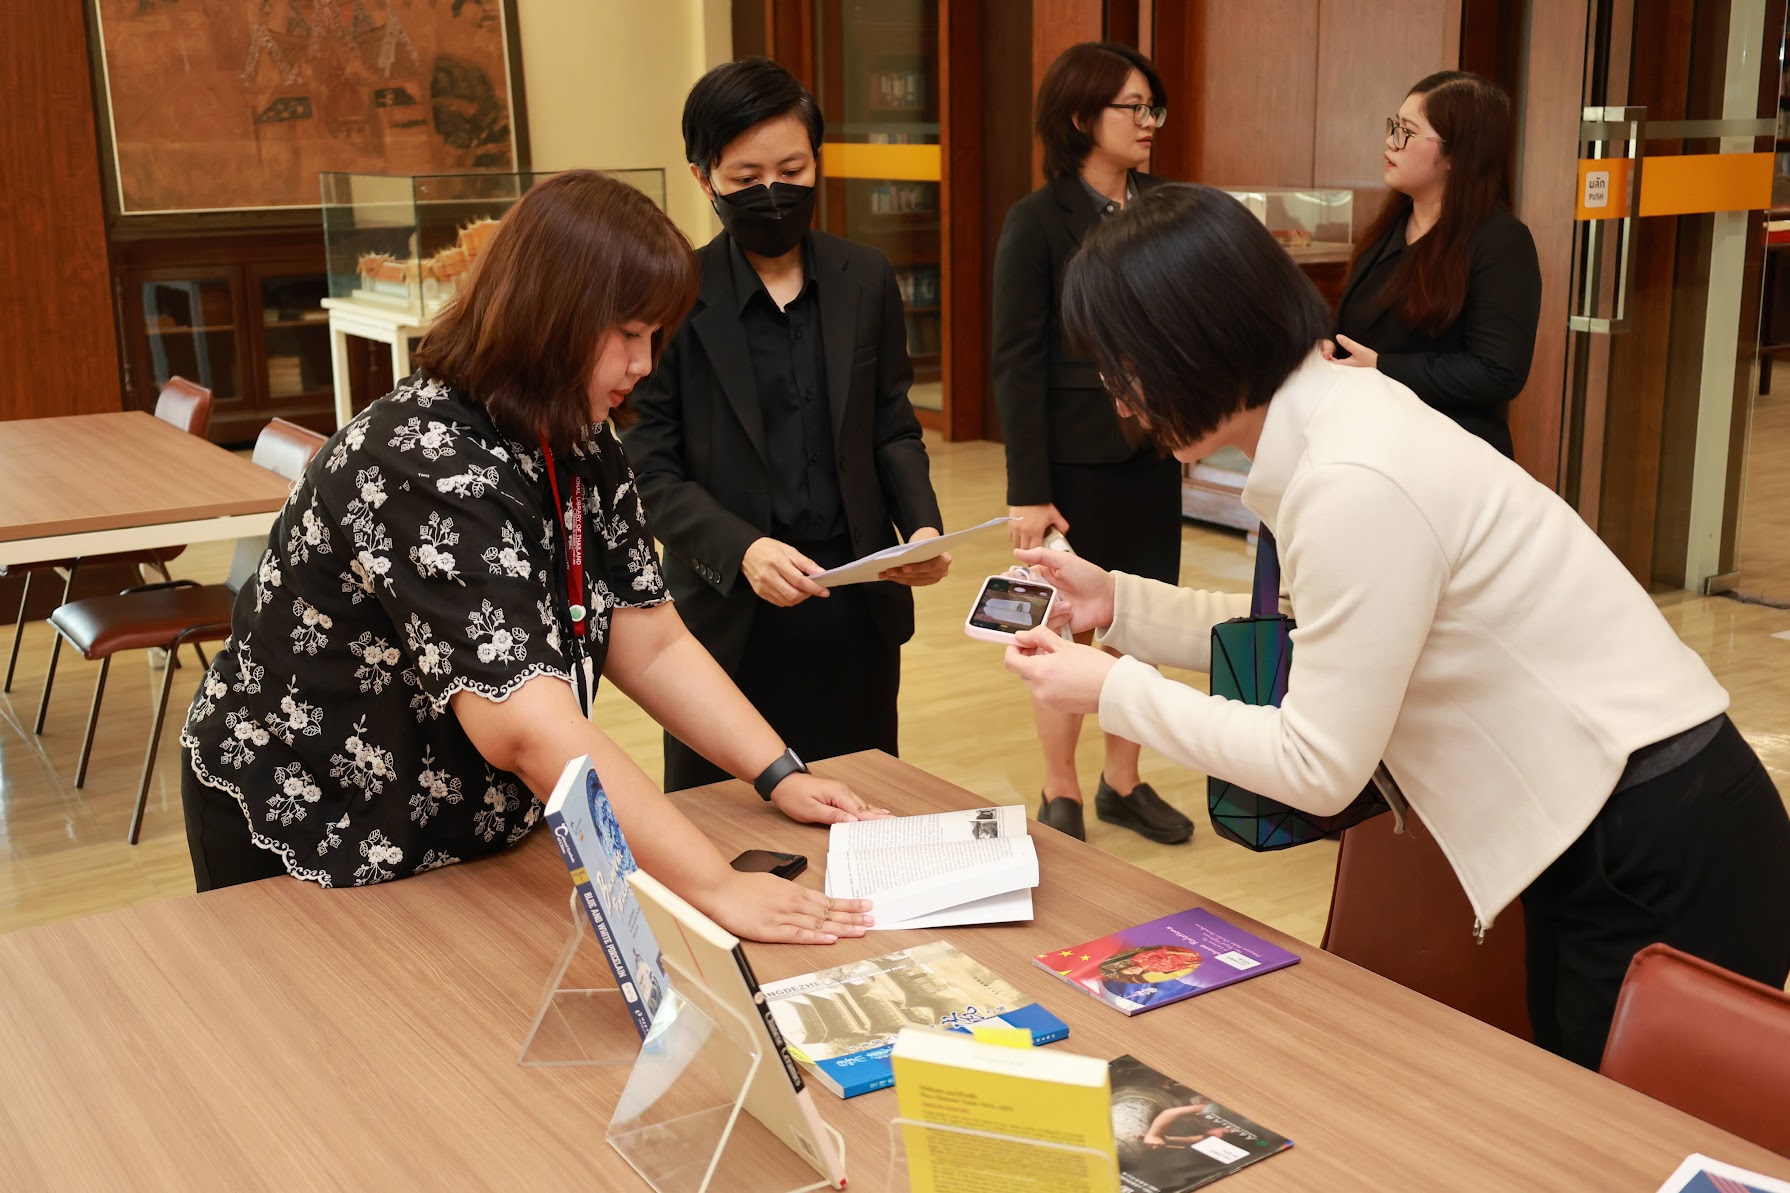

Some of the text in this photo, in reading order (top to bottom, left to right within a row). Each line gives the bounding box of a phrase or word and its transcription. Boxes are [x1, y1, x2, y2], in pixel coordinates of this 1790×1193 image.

[1589, 177, 1605, 189] ผลัก
[577, 523, 582, 533] OF
[583, 891, 597, 909] BLUE
[590, 907, 603, 924] AND
[597, 922, 612, 945] WHITE
[606, 943, 627, 979] PORCELAIN
[762, 981, 820, 999] INGDEZHE
[764, 1011, 802, 1087] Chinese Ceramics
